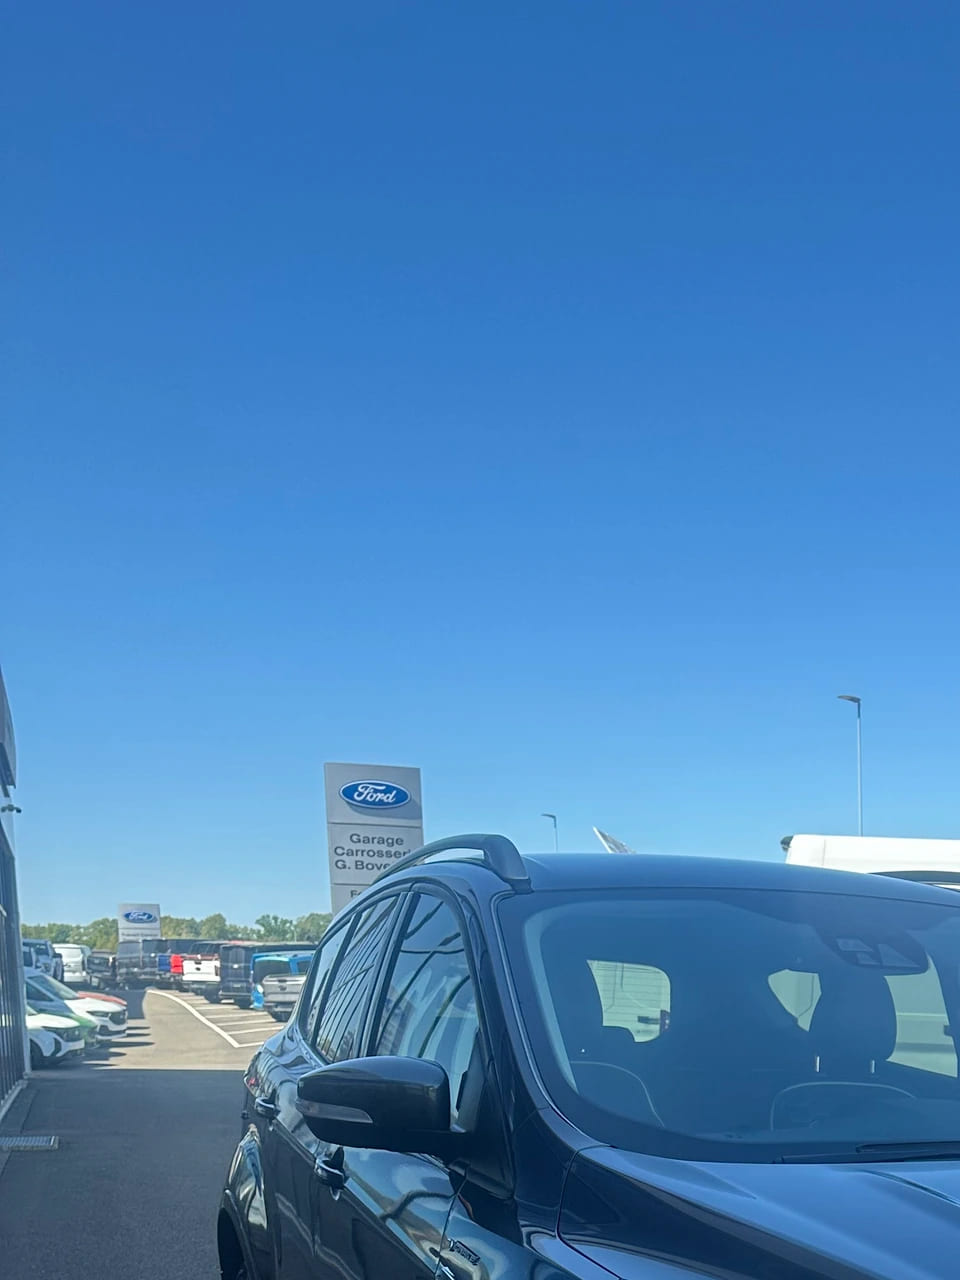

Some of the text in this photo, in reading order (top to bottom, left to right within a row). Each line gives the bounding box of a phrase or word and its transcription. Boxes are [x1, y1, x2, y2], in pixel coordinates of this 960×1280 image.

[353, 783, 397, 803] Ford
[349, 833, 404, 847] Garage
[334, 859, 351, 870] G.
